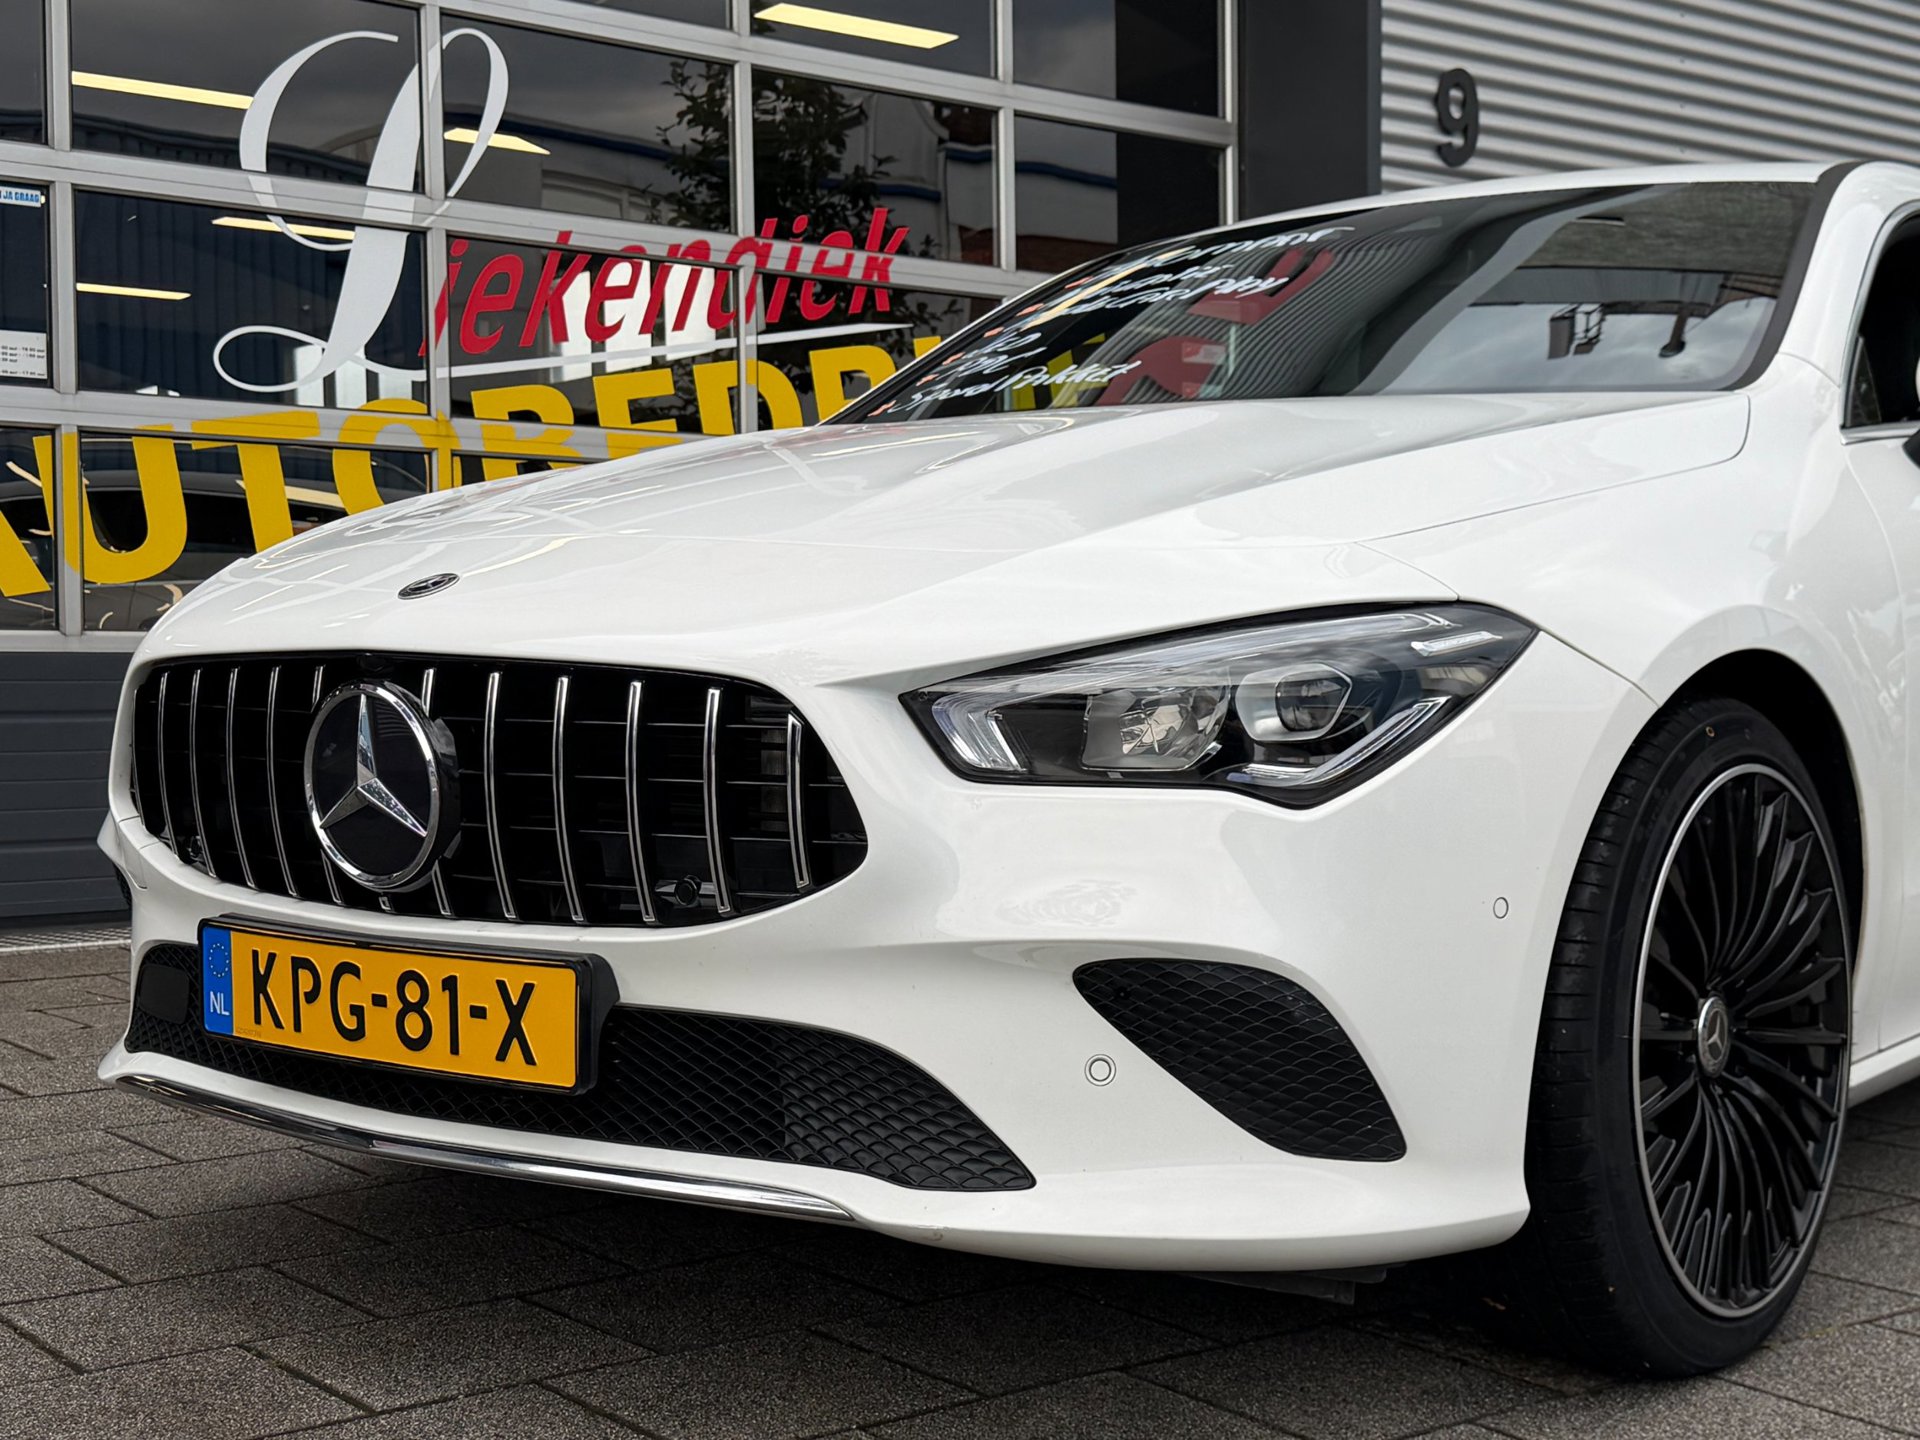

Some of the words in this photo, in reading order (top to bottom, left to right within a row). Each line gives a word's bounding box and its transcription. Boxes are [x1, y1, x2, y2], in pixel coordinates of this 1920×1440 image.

[1435, 68, 1479, 167] 9
[209, 990, 230, 1017] NL
[251, 948, 538, 1067] KPG-81-X
